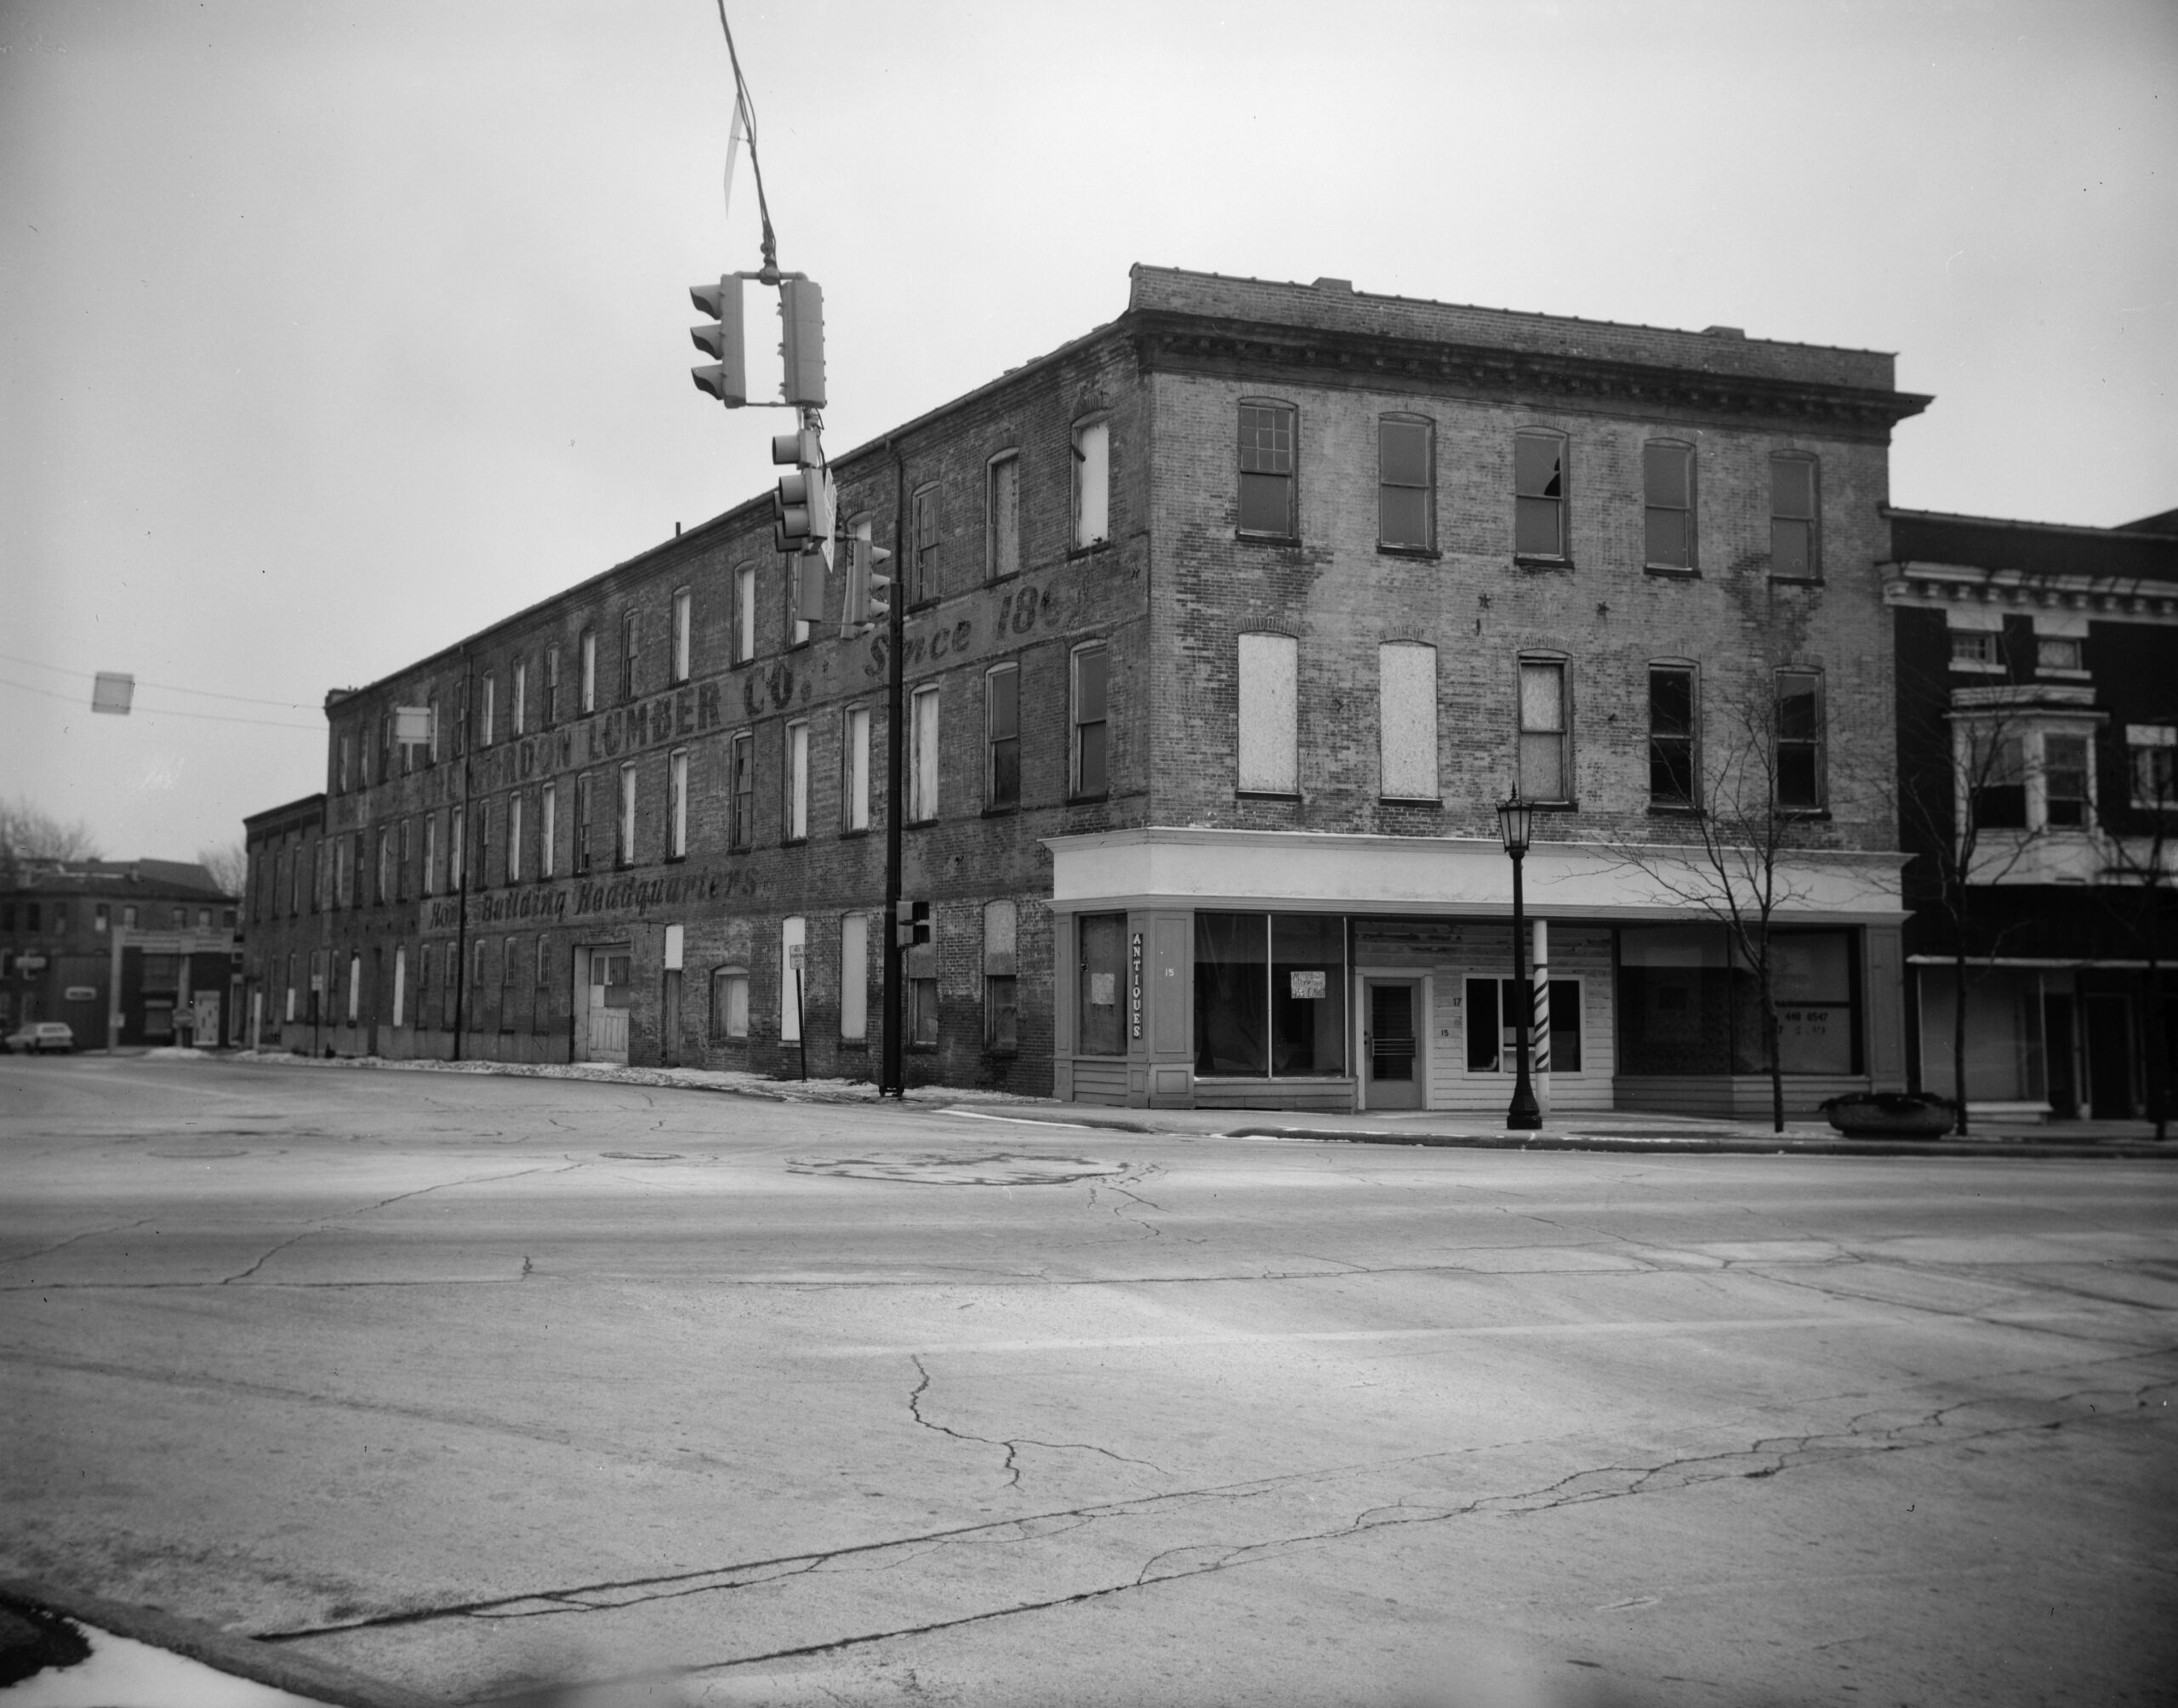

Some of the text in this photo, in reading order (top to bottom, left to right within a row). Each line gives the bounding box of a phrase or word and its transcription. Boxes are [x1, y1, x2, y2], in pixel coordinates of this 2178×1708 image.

[589, 681, 721, 761] LUMBER
[743, 663, 812, 715] CO.
[864, 619, 972, 677] Snce
[481, 885, 567, 923] Building
[574, 866, 759, 916] Headquarters
[1132, 933, 1142, 1038] ANTIQUES
[1165, 968, 1175, 977] 15
[1453, 997, 1462, 1006] 17
